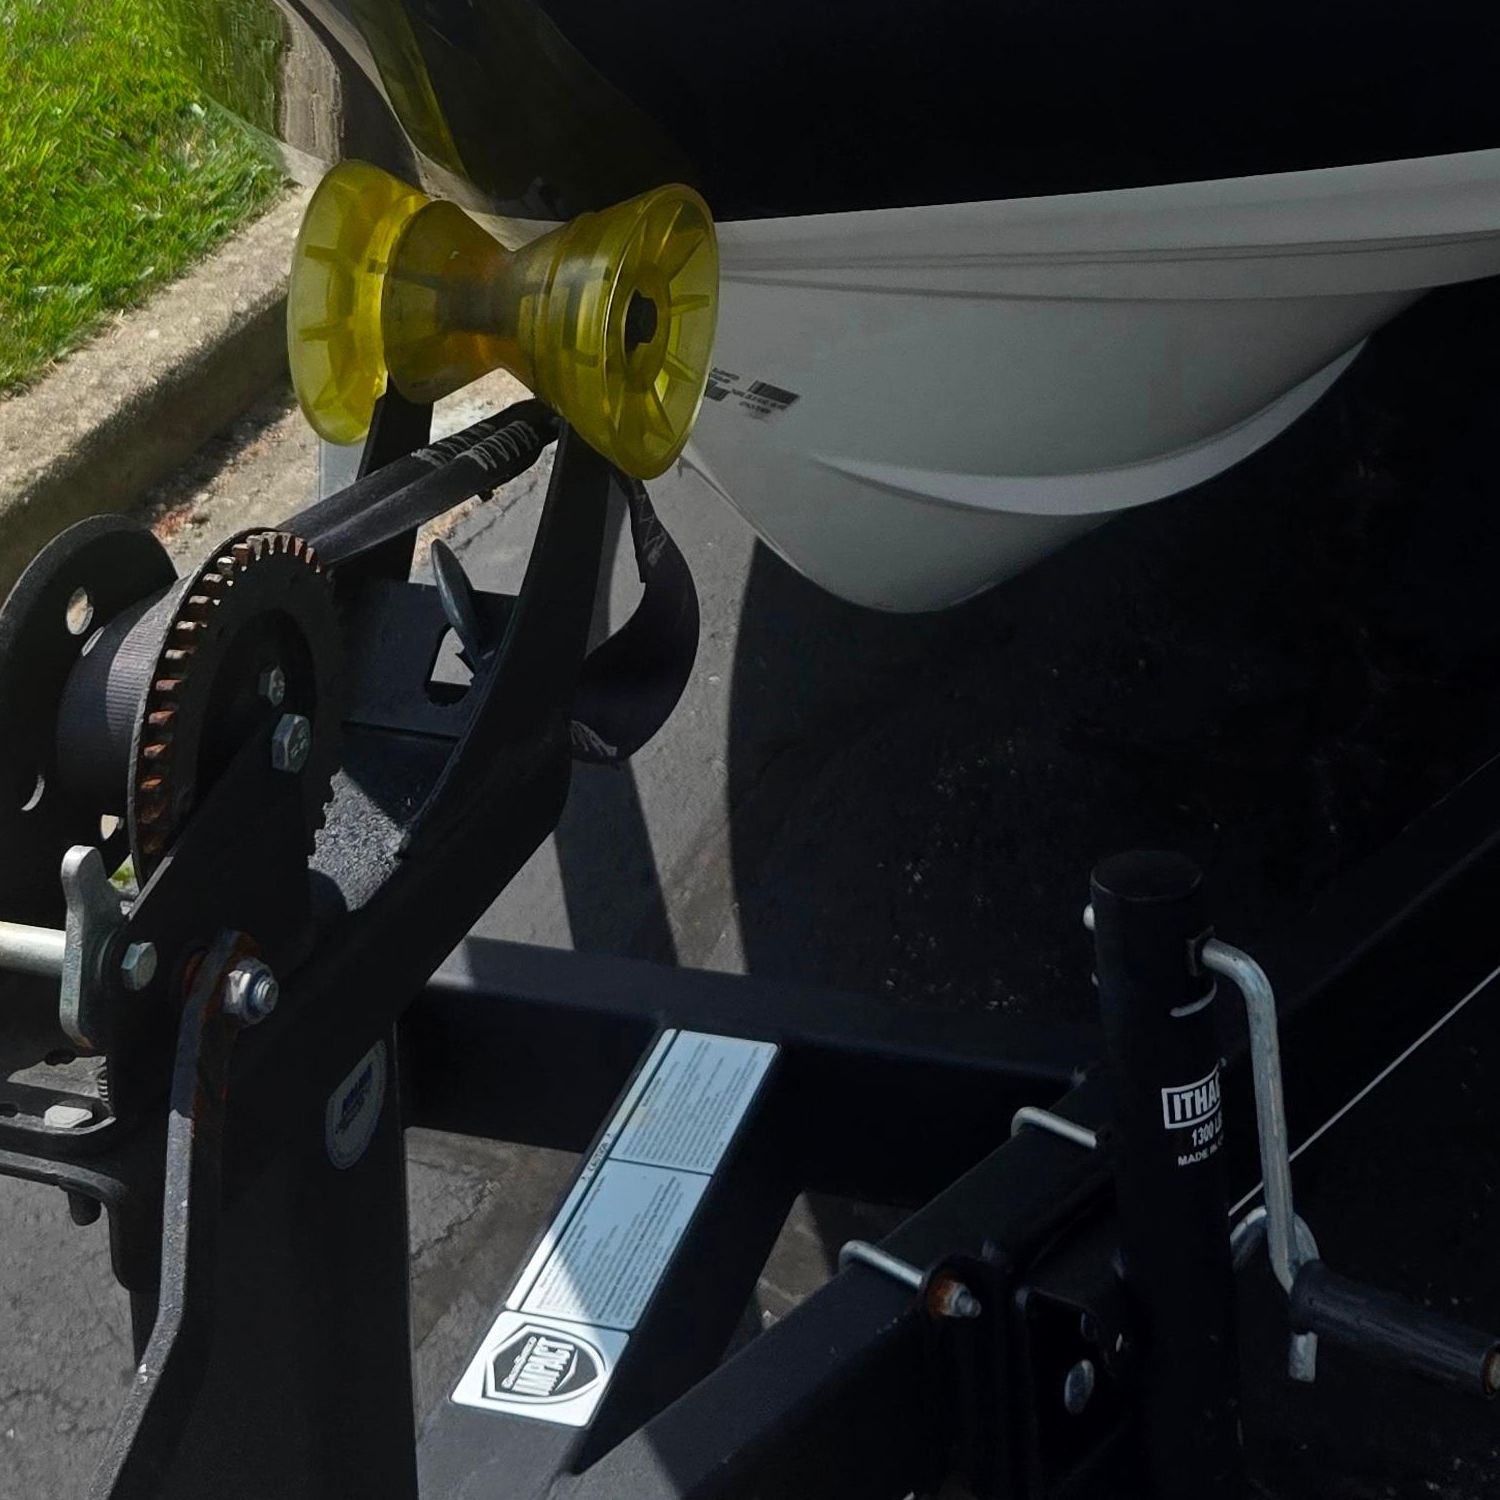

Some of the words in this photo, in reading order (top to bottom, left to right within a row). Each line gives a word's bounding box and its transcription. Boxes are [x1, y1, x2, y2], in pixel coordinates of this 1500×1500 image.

[1192, 1120, 1214, 1147] 1300
[1178, 1148, 1209, 1166] MADE
[511, 1336, 575, 1397] IMPACT
